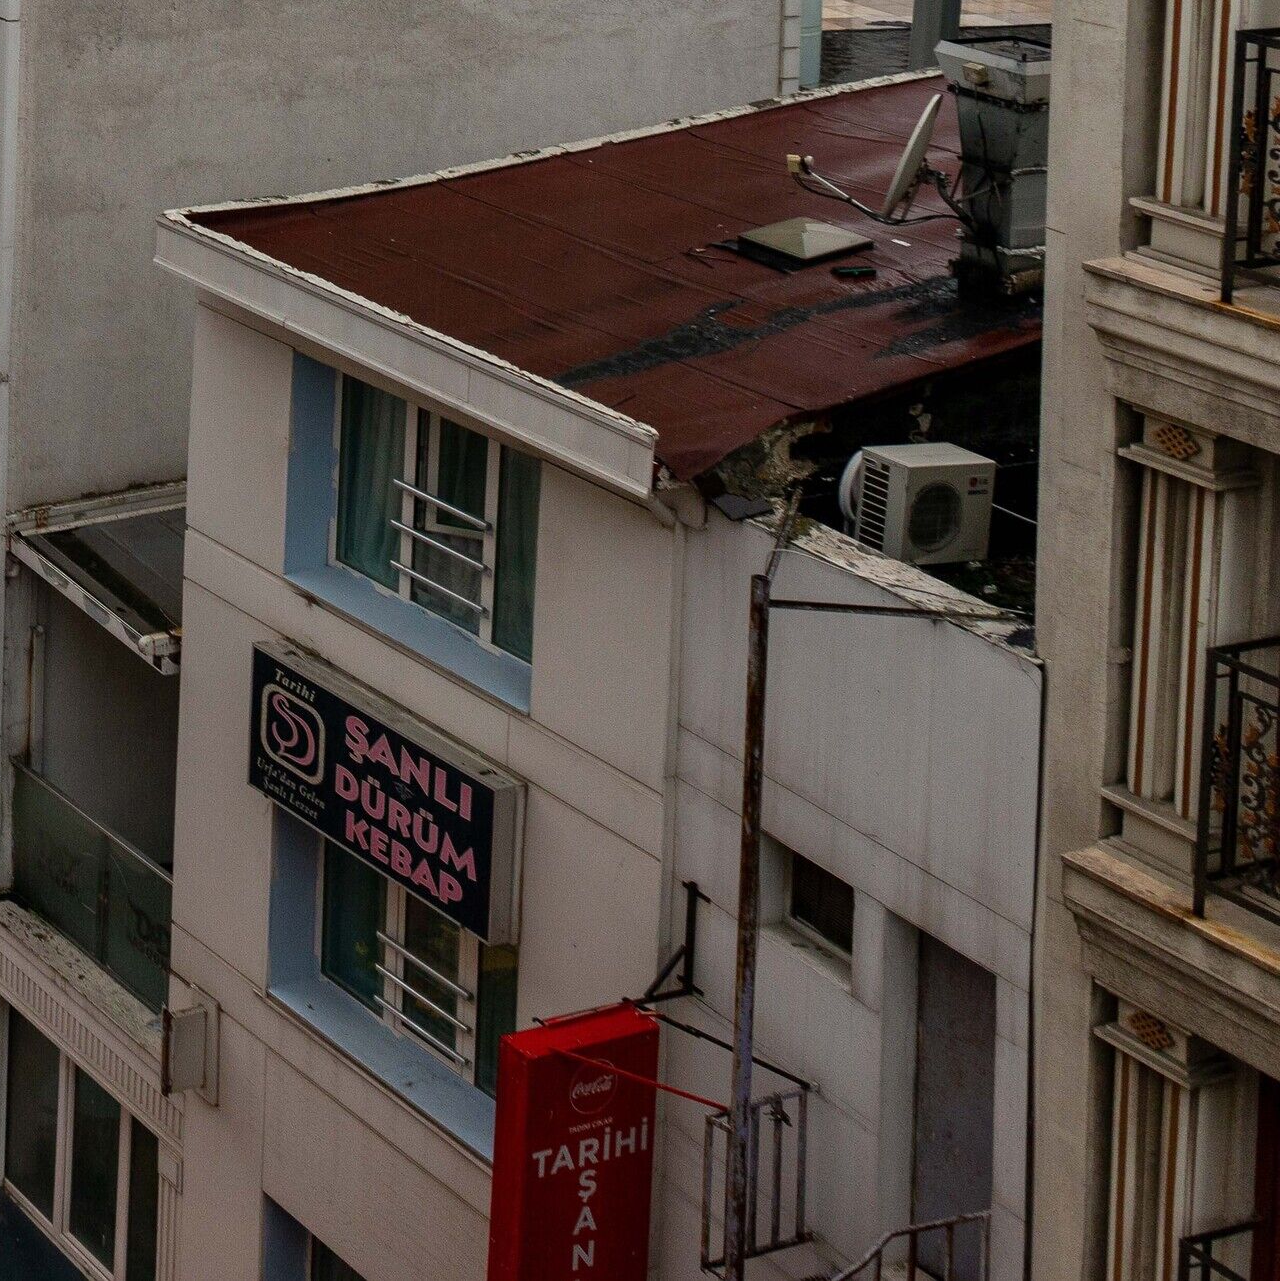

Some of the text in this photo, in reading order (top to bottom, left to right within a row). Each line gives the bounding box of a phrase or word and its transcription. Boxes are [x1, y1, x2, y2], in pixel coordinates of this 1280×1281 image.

[274, 668, 317, 703] Tarihi
[289, 793, 319, 821] Lezzet
[299, 781, 326, 810] Gelen
[344, 715, 474, 822] ŞANLI
[334, 762, 478, 882] DÜRÜM
[344, 813, 464, 906] KEBAP
[531, 1116, 650, 1179] TARİHİ
[571, 1169, 598, 1281] ŞAN
